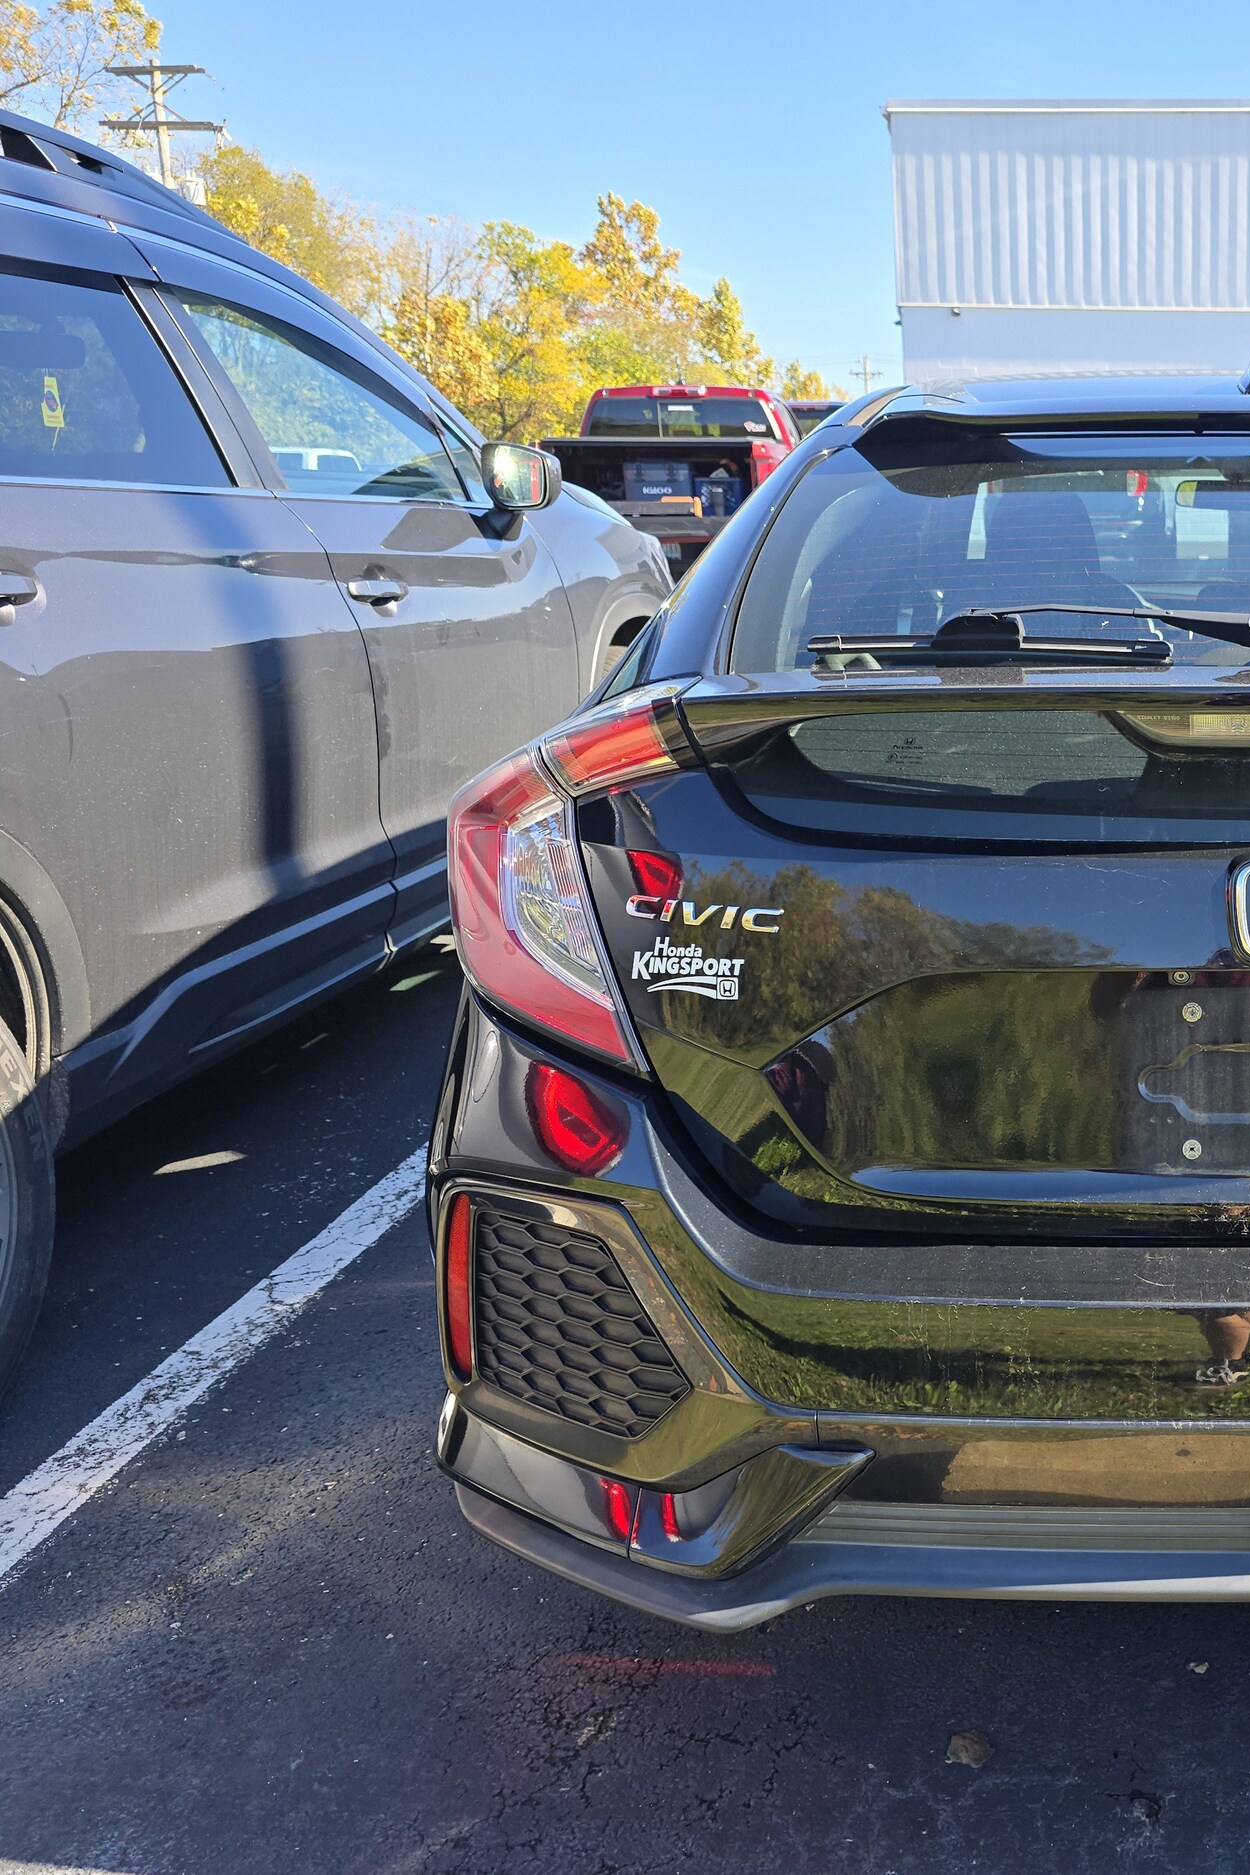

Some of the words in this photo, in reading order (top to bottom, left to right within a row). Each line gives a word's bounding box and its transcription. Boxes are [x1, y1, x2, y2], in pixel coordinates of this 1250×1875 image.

[642, 486, 673, 495] IGLOO
[625, 894, 785, 933] CIVIC
[653, 936, 703, 958] Honda
[631, 950, 745, 980] KINGSPORT
[0, 1040, 43, 1162] EXEN
